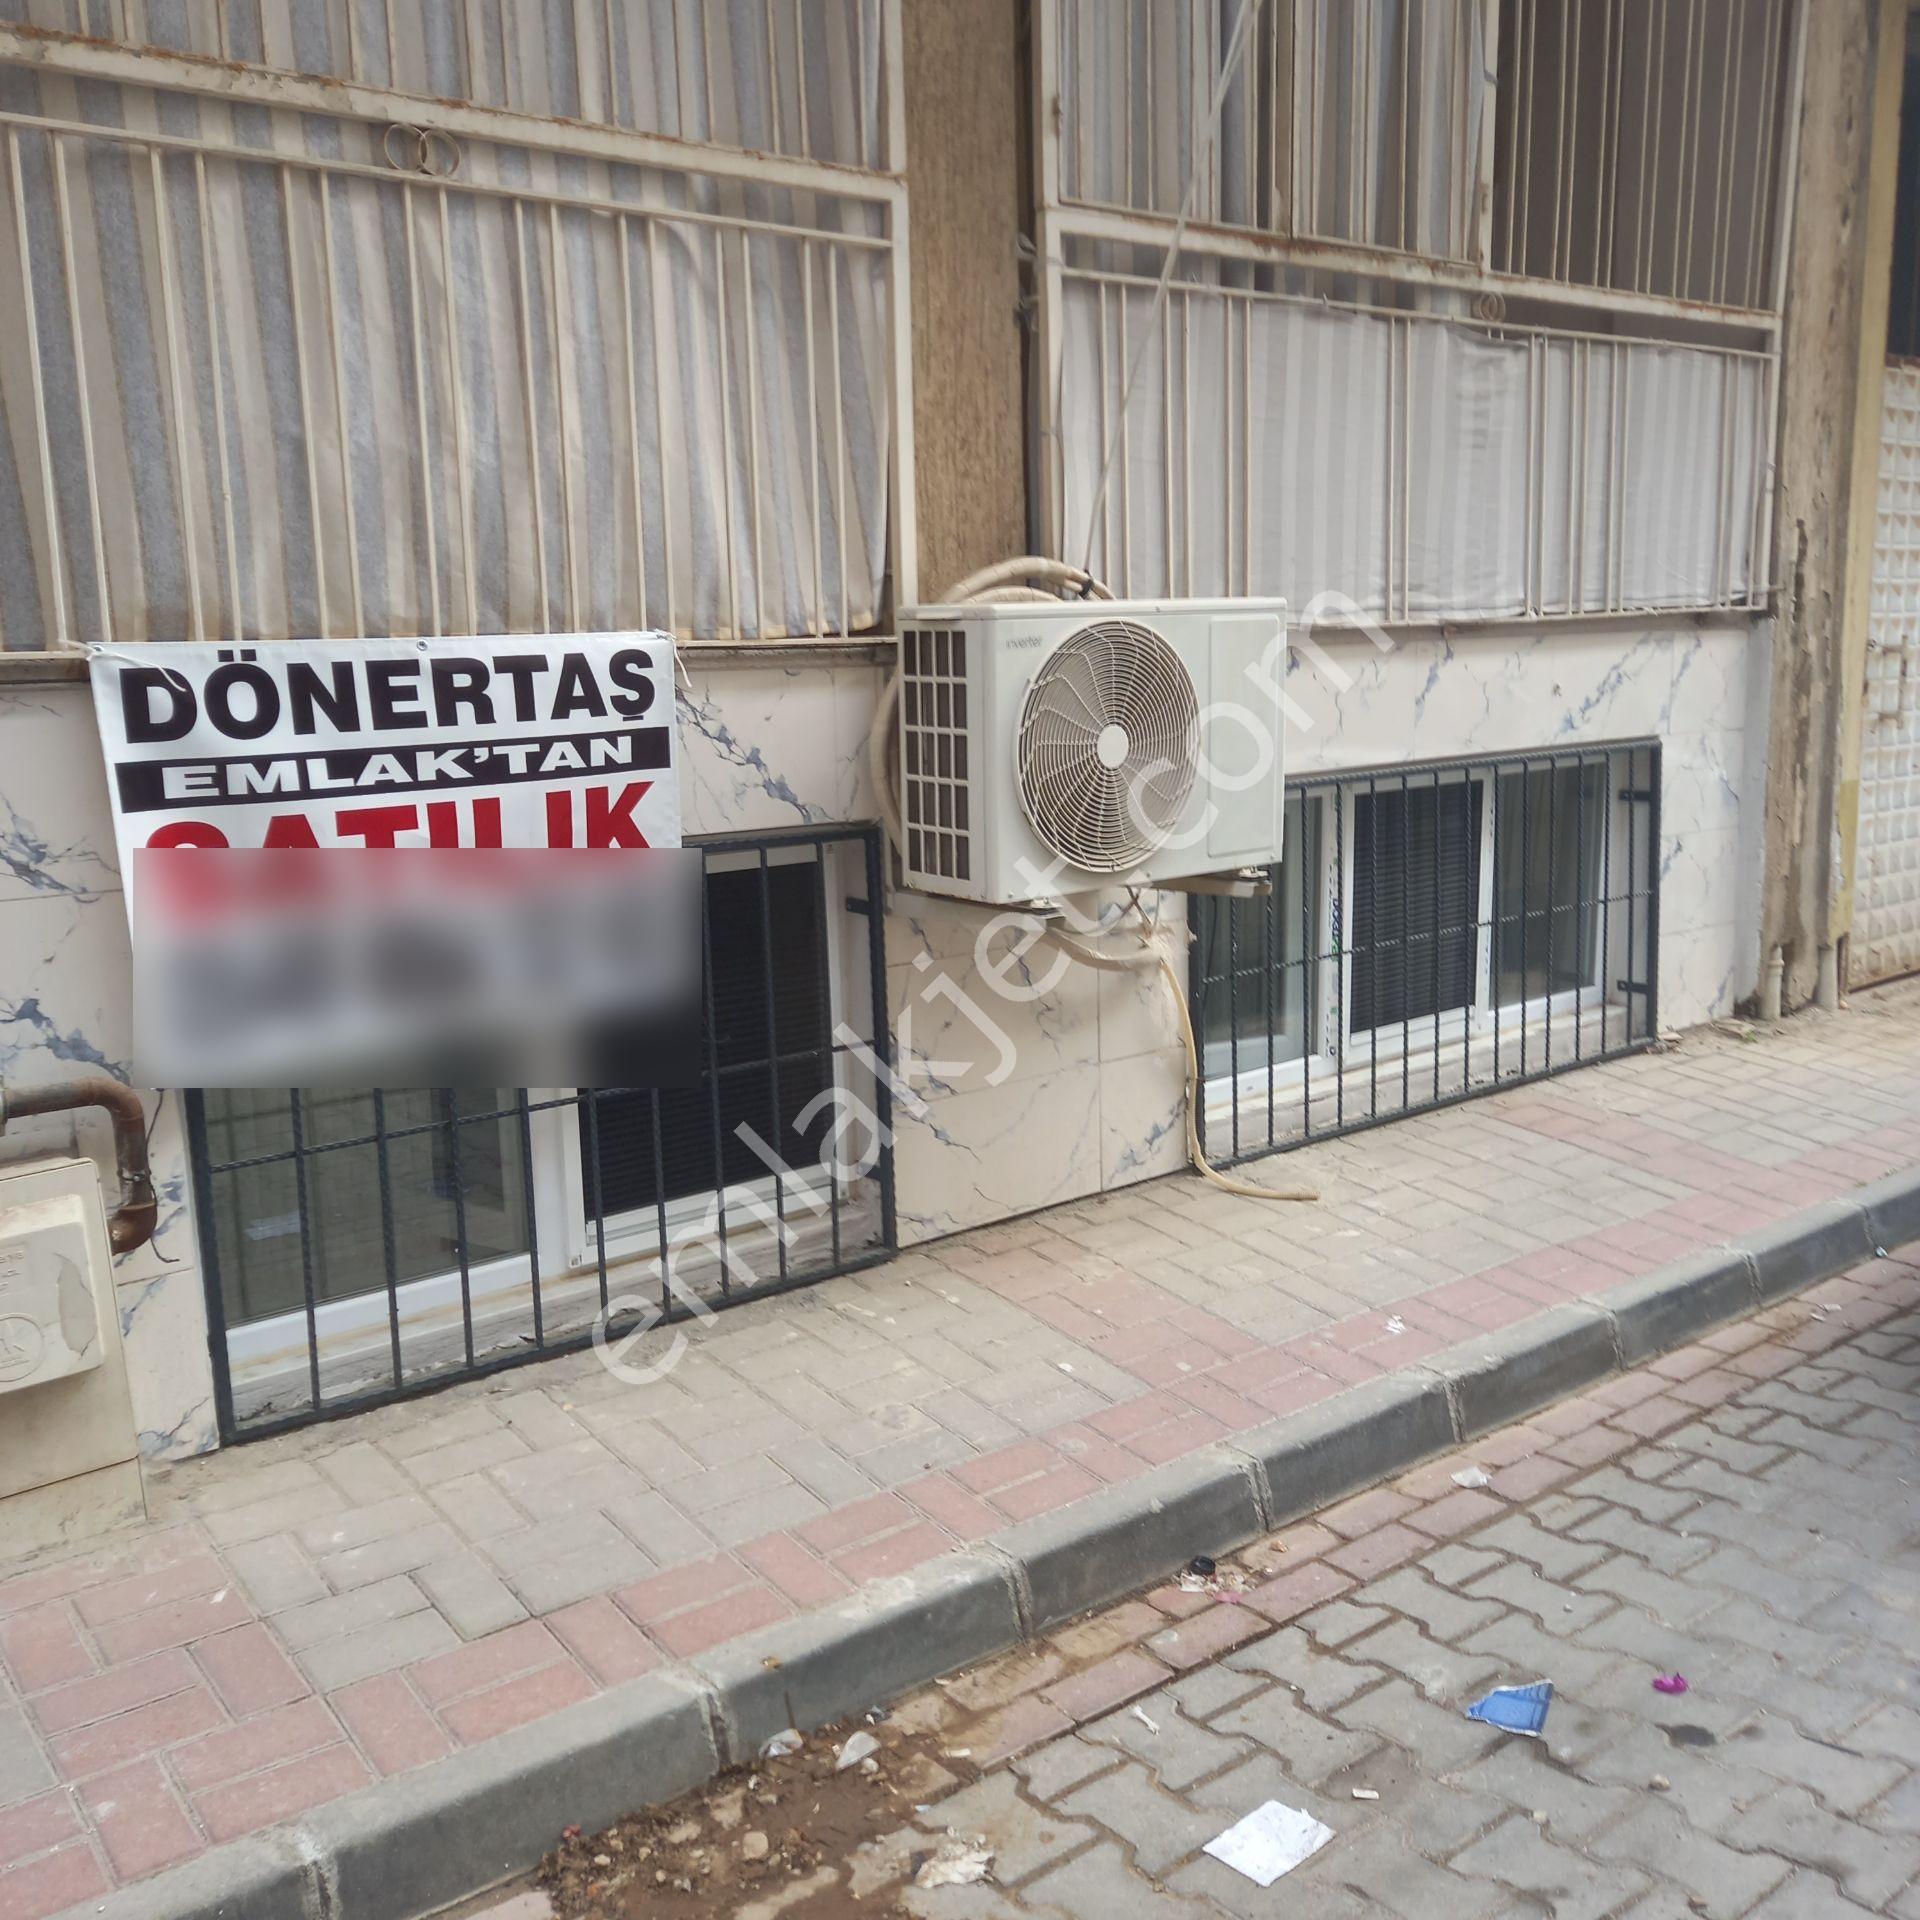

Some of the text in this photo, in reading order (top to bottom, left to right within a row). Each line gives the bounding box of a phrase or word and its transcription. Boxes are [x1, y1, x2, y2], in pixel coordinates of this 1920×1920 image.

[119, 648, 656, 744] DÖNERTAŞ
[161, 736, 633, 799] EMLAK'TAN
[146, 780, 654, 849] TIIK
